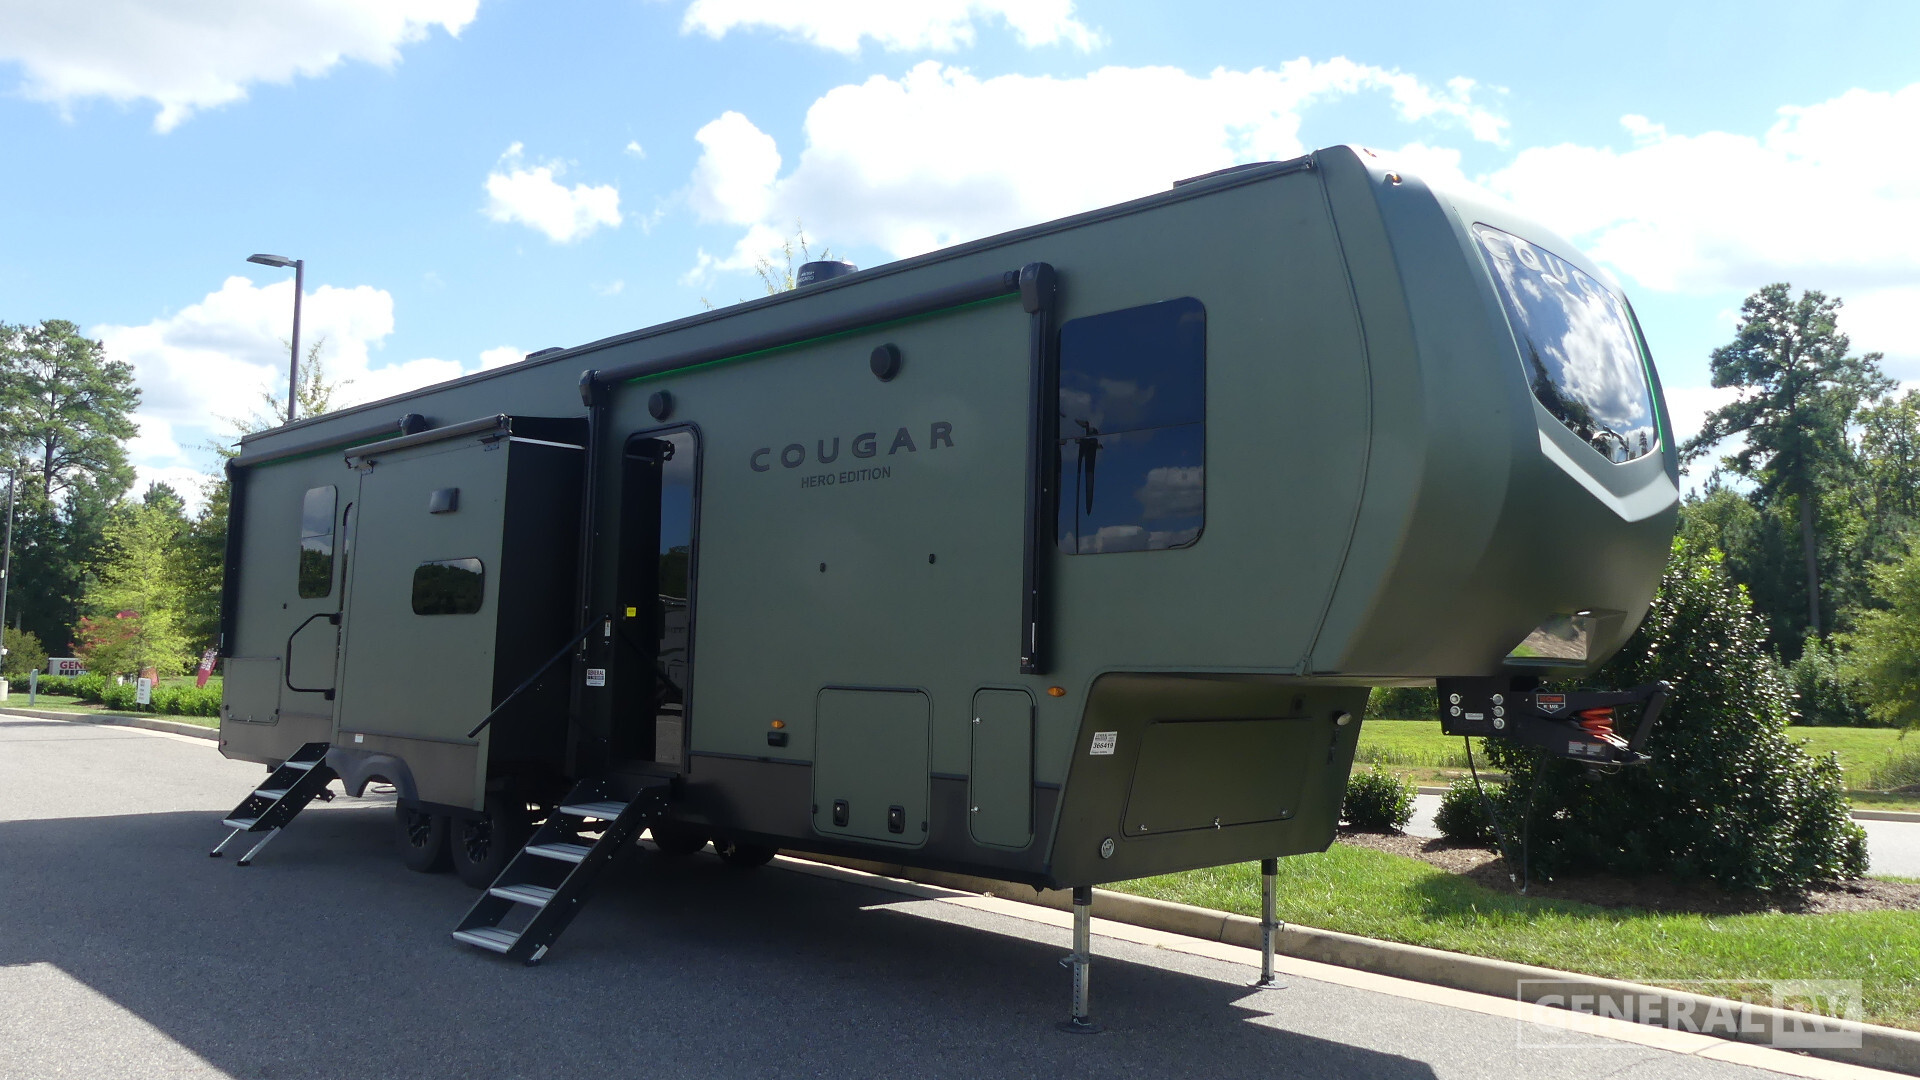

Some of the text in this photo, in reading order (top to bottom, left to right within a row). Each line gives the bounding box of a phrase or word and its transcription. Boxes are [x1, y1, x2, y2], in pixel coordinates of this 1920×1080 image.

[750, 421, 955, 473] COUGAR
[801, 466, 892, 489] HERO EDITION
